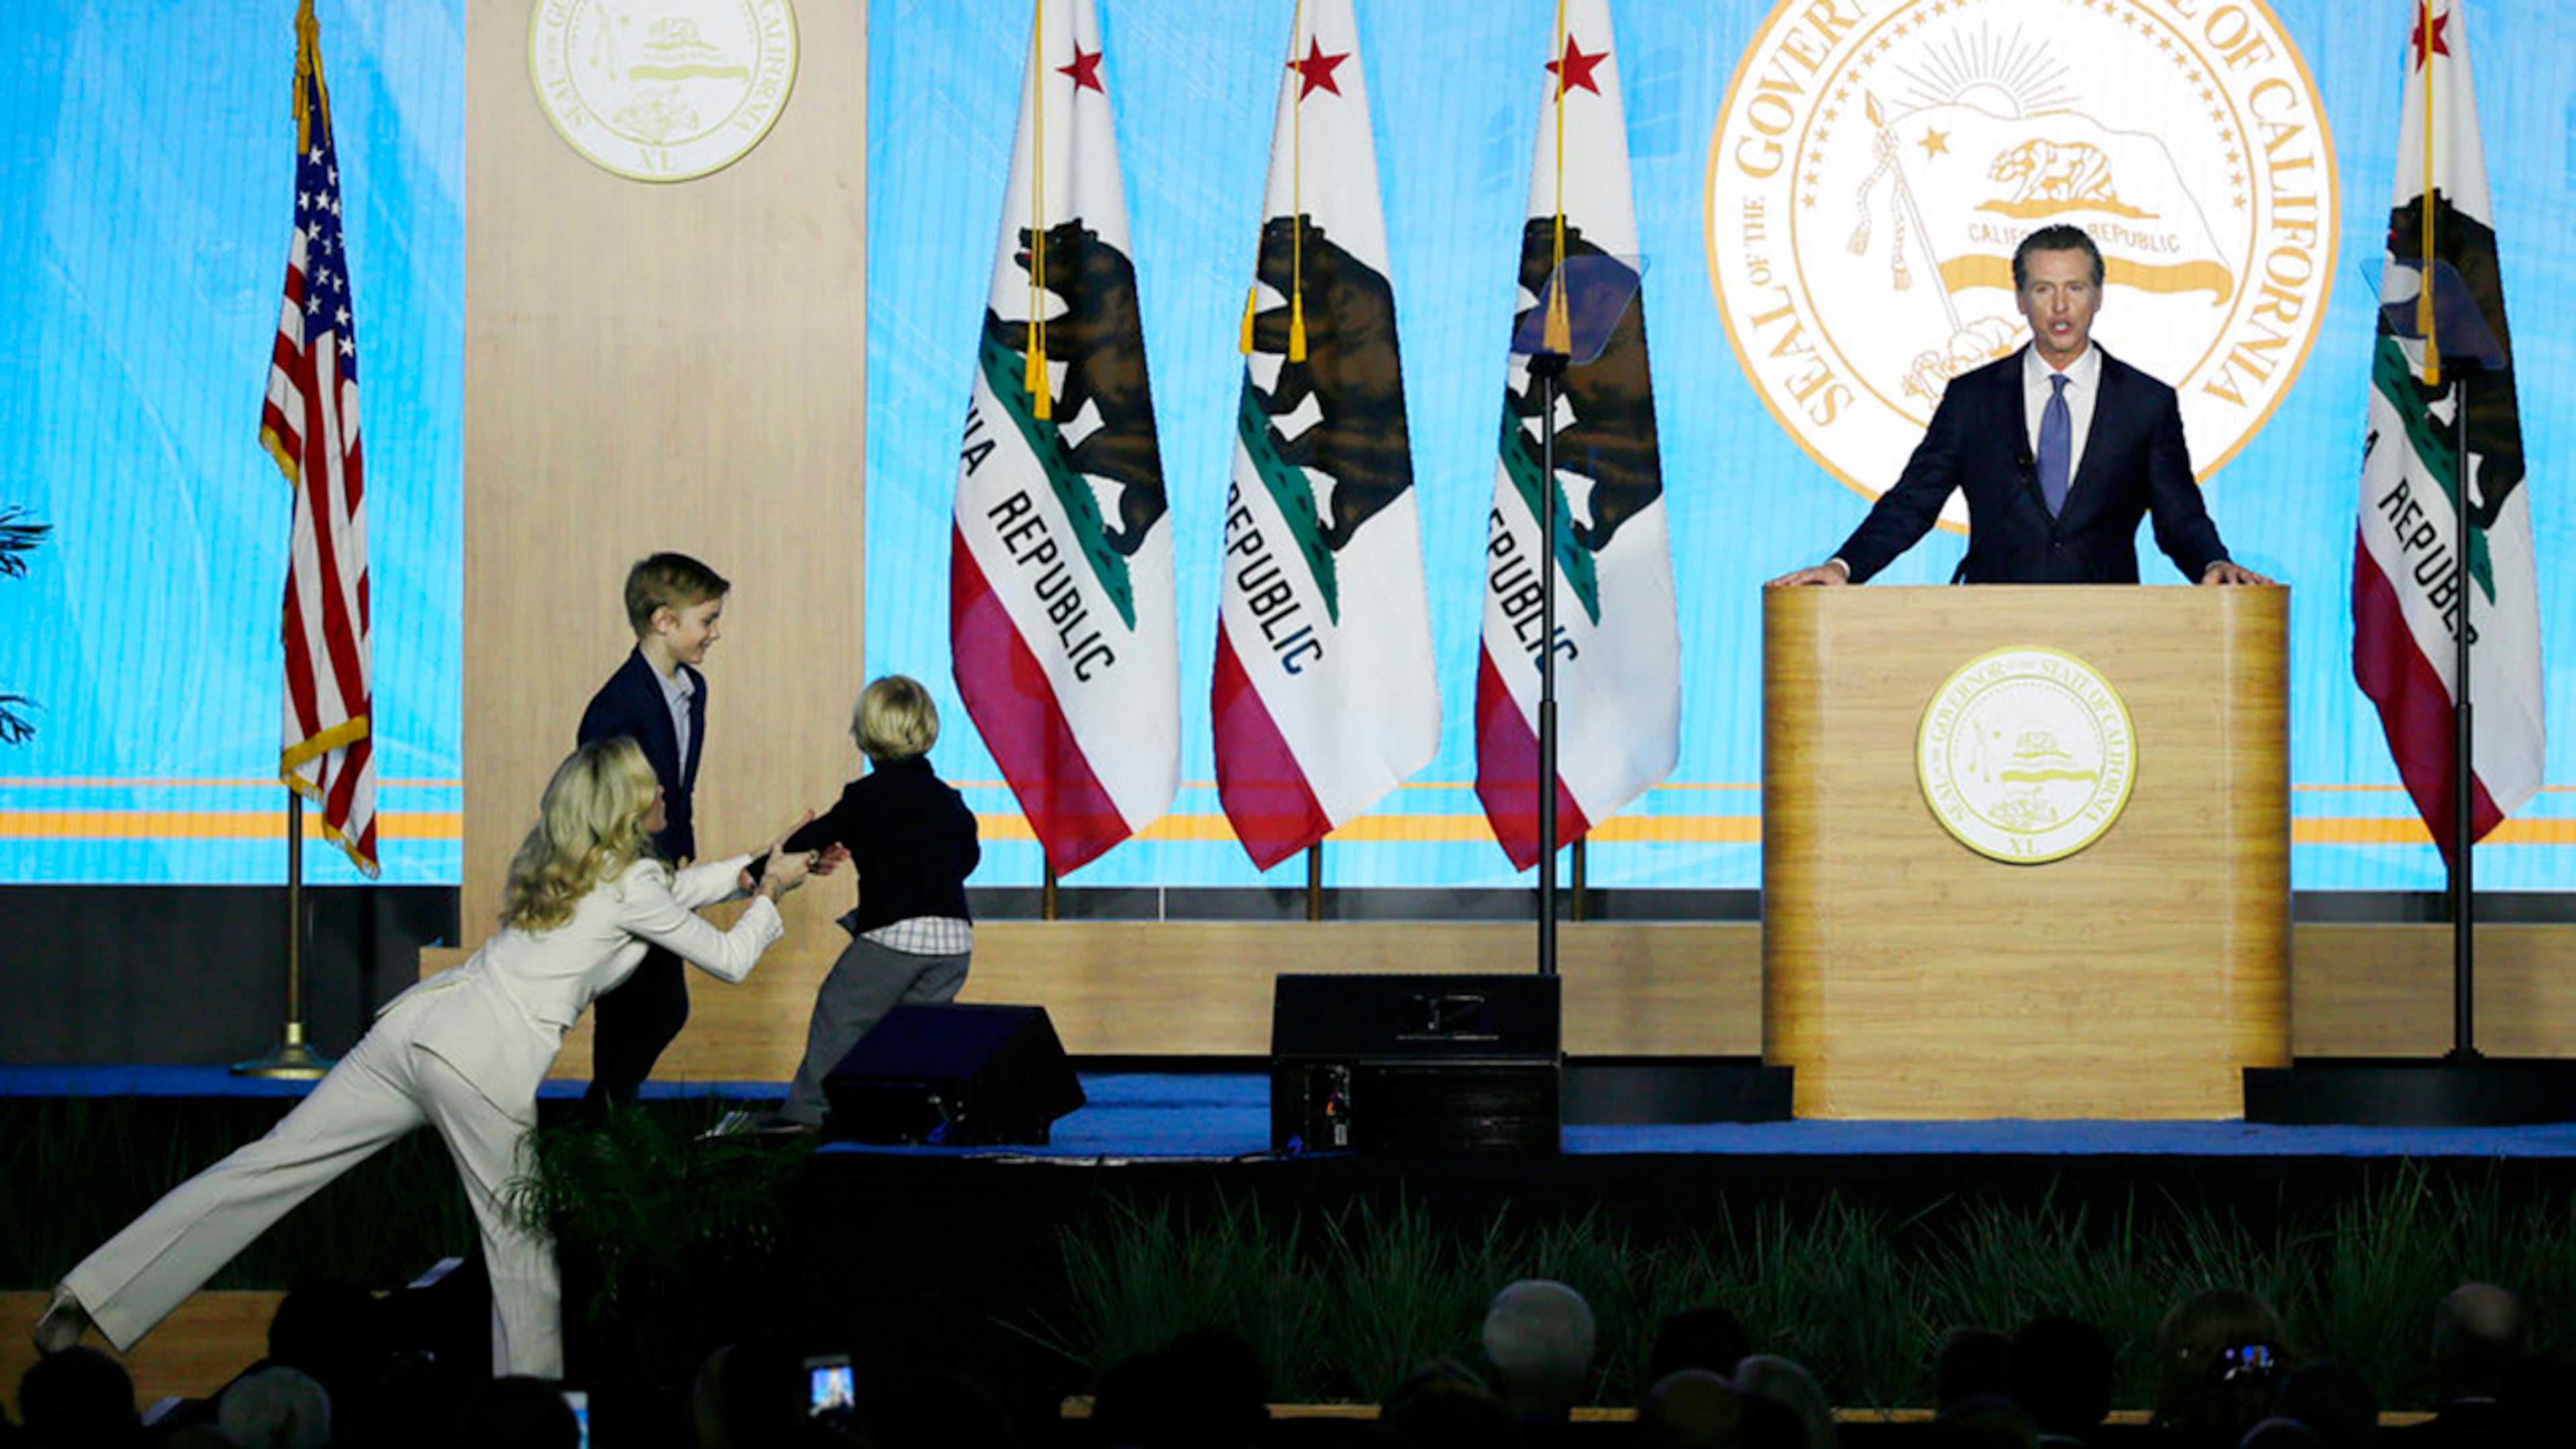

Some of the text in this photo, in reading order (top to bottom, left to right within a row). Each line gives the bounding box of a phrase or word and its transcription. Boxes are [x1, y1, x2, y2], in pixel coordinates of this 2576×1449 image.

[1735, 0, 1868, 427] SEAL OF THE GOVER
[2086, 223, 2181, 253] REPUBLIC
[2201, 5, 2319, 407] OF CALIFORNIA
[987, 490, 1116, 683] REPUBLIC
